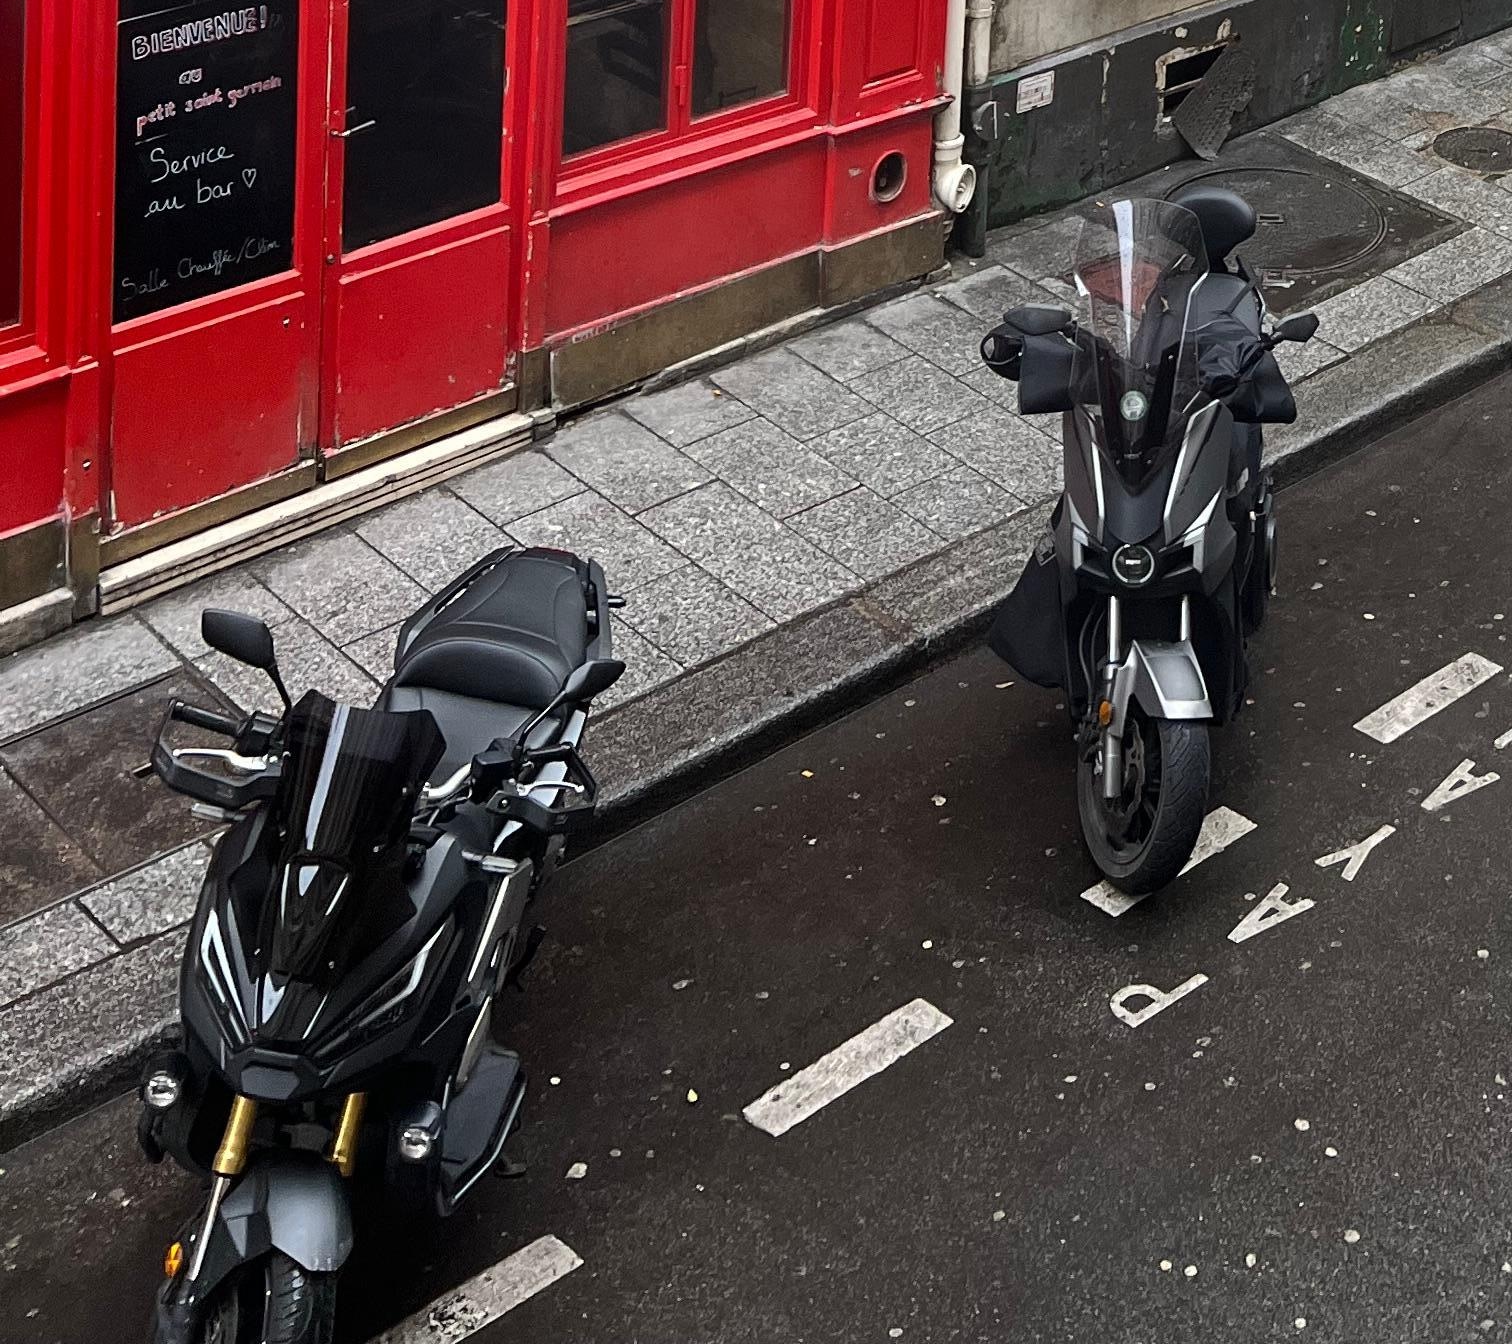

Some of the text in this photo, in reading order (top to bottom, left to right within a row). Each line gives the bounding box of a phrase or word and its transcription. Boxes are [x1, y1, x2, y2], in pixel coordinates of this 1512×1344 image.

[137, 75, 282, 136] petit saint germain
[150, 146, 235, 183] Service
[144, 178, 234, 217] au bar
[122, 268, 169, 301] Salle
